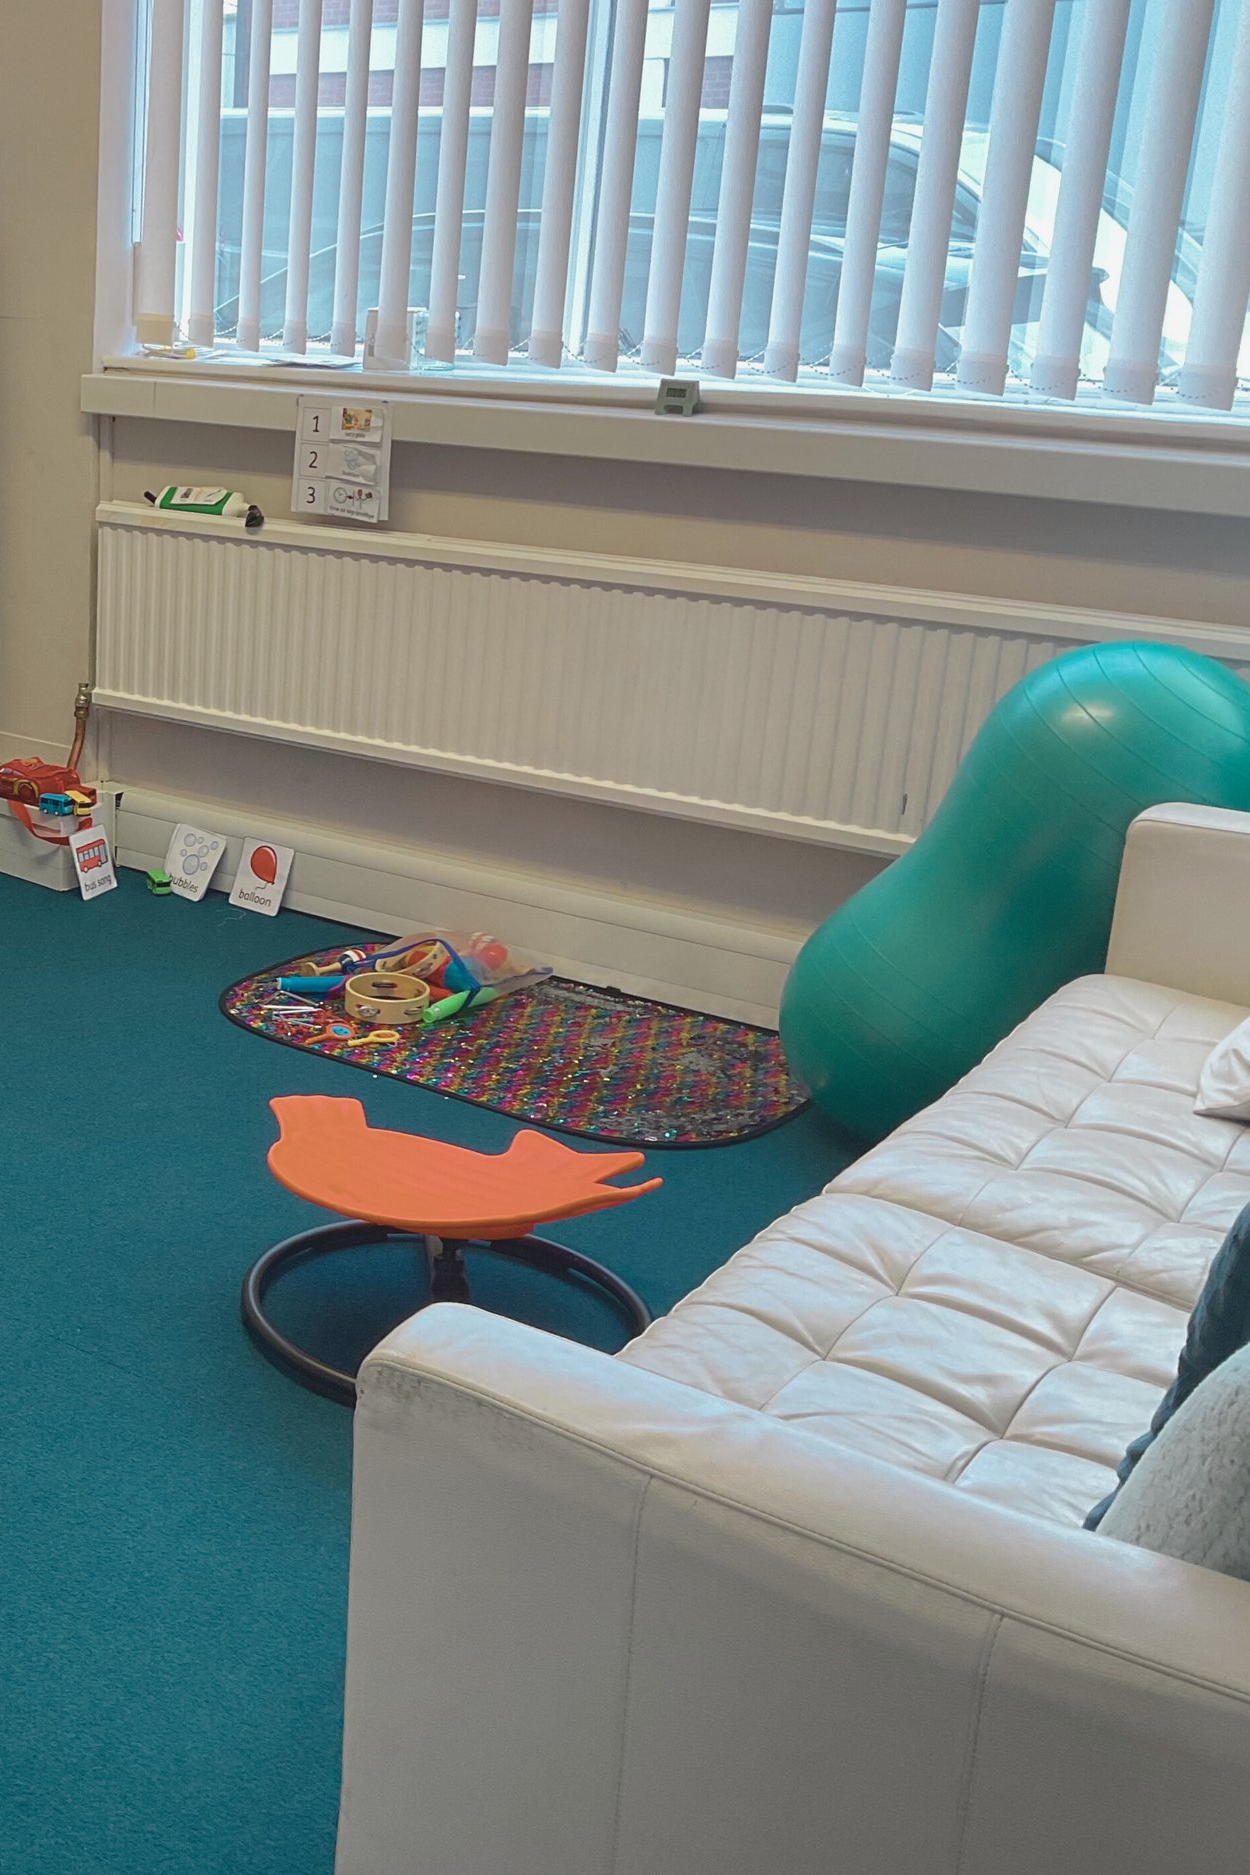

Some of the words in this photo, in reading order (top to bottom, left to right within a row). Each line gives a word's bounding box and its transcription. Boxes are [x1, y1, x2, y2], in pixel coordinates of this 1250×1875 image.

[312, 415, 320, 433] 1
[308, 451, 318, 469] 2
[306, 486, 316, 504] 3
[84, 882, 97, 892] bus
[97, 874, 112, 888] song
[238, 888, 272, 907] balloon
